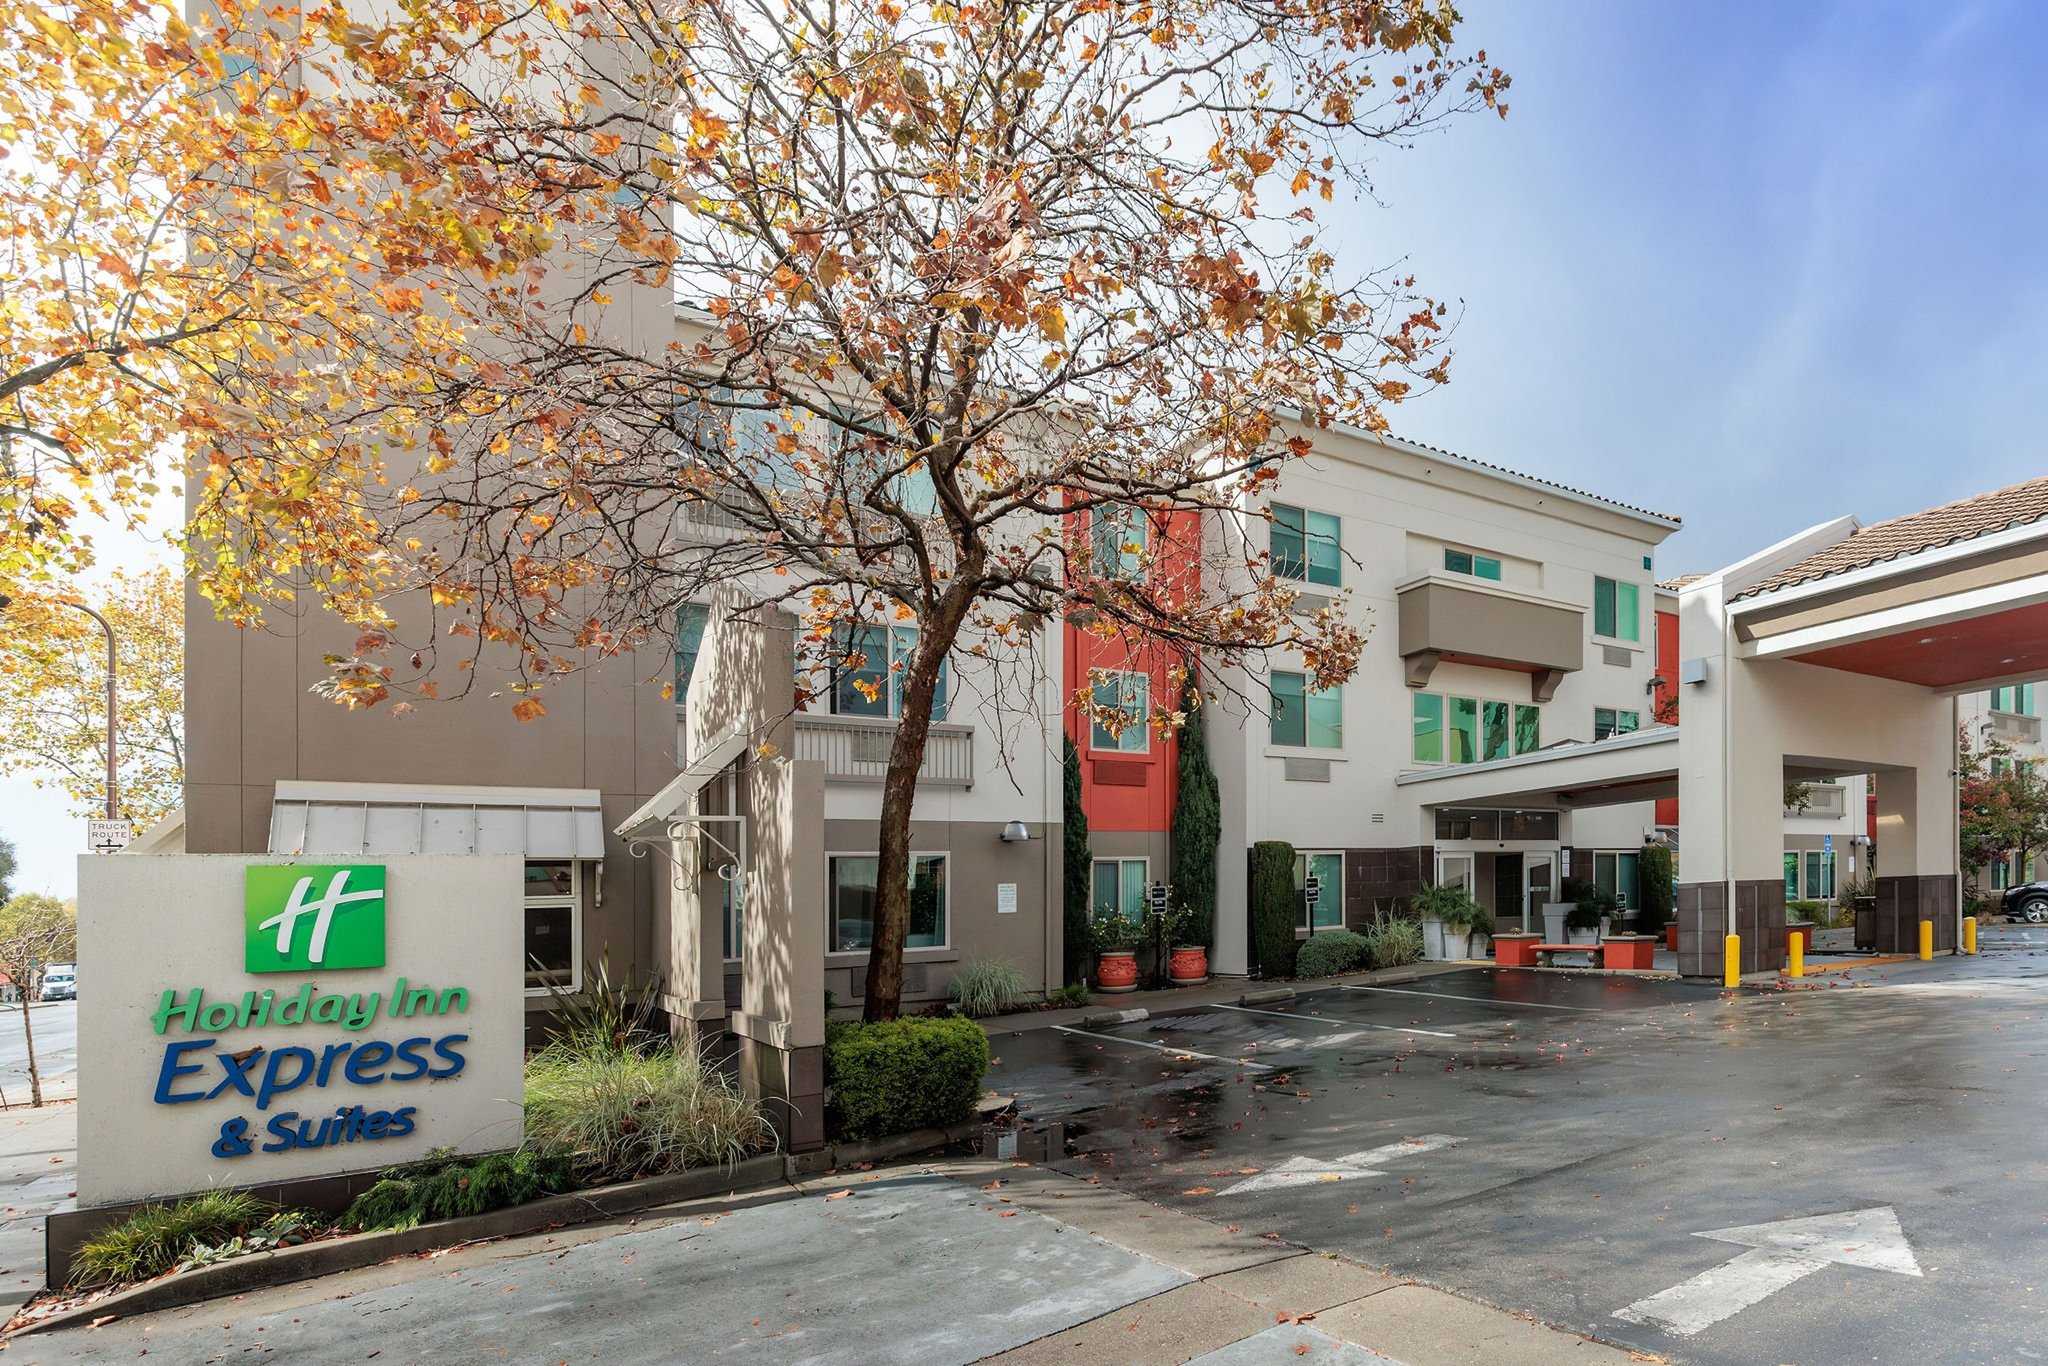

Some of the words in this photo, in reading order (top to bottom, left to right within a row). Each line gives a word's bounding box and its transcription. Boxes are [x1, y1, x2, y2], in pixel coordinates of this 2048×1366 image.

[259, 870, 384, 963] H
[151, 982, 381, 1034] Holiday
[388, 977, 470, 1017] Inn
[154, 1034, 469, 1110] Express
[211, 1116, 253, 1158] &
[262, 1104, 417, 1152] Suites
